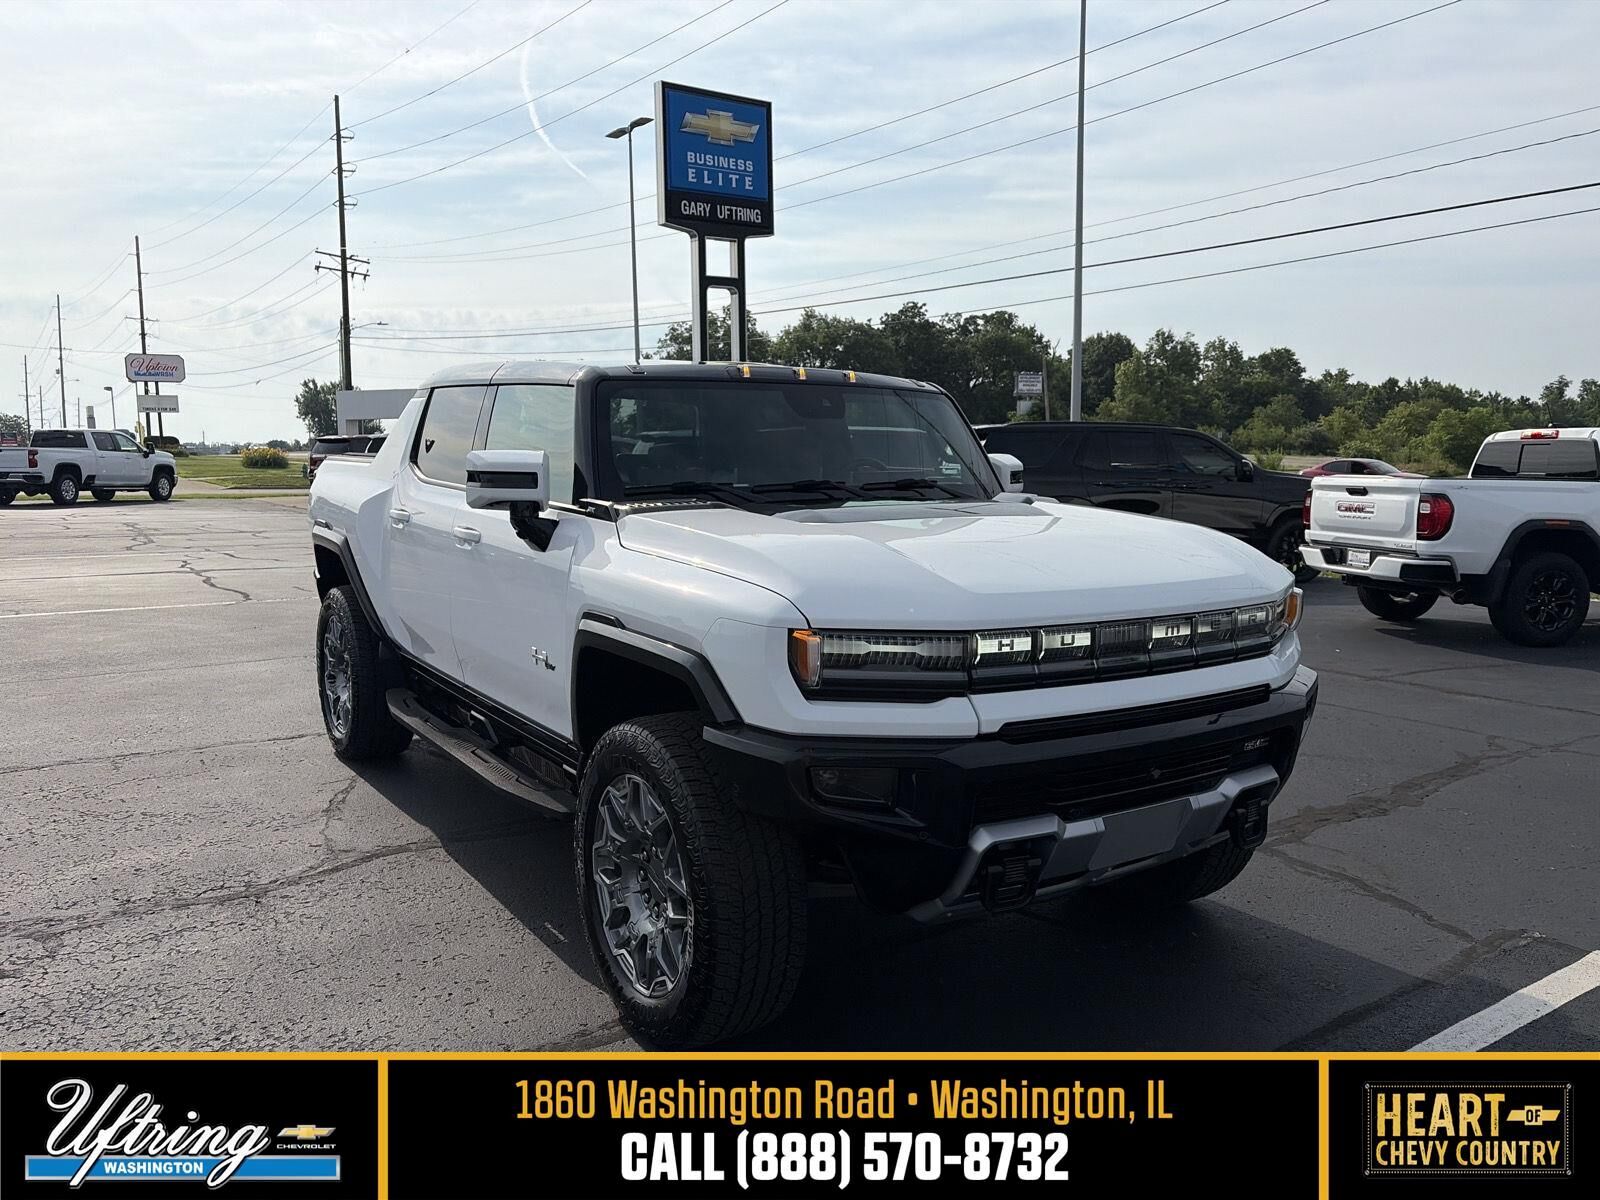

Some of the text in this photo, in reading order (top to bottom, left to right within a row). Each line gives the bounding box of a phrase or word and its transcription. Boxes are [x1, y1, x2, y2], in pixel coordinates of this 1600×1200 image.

[687, 151, 754, 171] BUSINESS
[688, 168, 754, 190] ELITE
[681, 199, 762, 223] GARY UFTRING
[130, 357, 178, 373] Uptown
[1337, 502, 1375, 514] GMC
[997, 611, 1261, 651] HUMER
